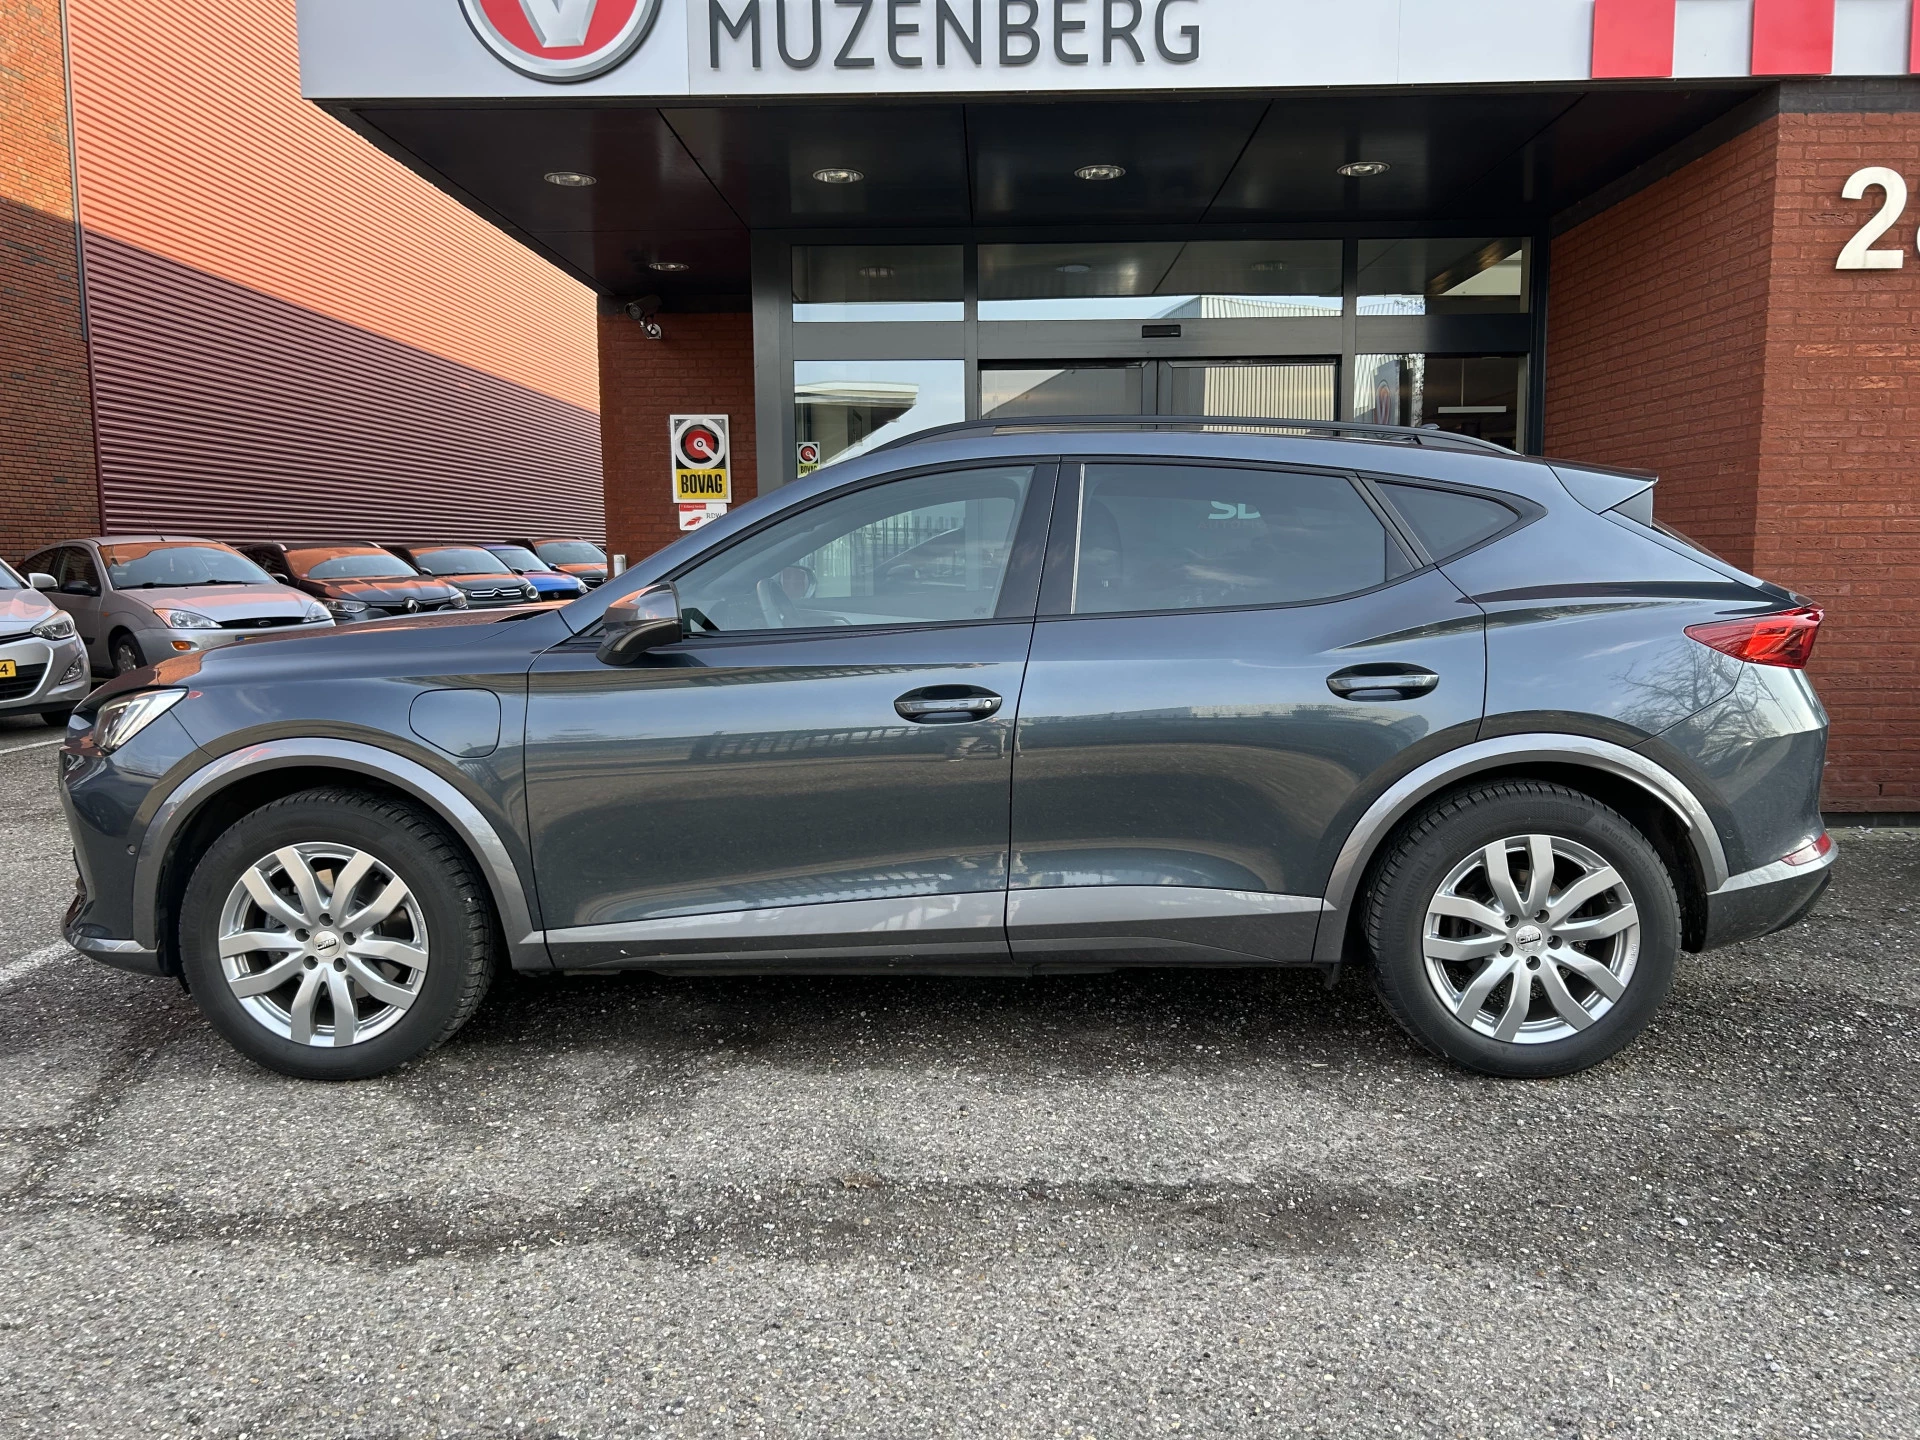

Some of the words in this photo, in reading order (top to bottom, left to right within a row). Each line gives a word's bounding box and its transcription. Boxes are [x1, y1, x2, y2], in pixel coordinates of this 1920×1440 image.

[709, 0, 1200, 68] MUZENBERG
[1835, 166, 1920, 269] 2
[681, 474, 722, 494] BOVAG
